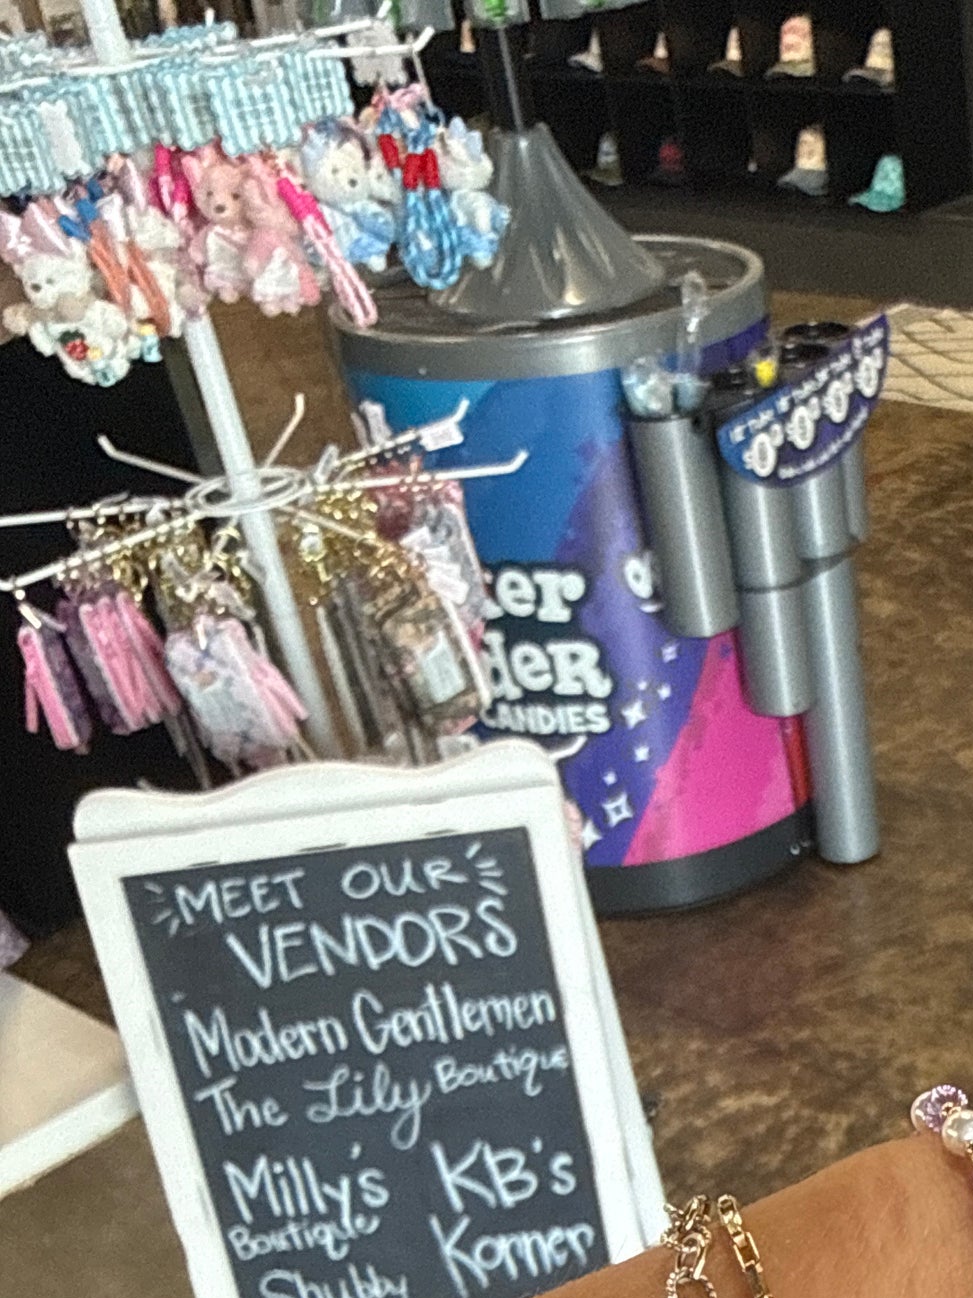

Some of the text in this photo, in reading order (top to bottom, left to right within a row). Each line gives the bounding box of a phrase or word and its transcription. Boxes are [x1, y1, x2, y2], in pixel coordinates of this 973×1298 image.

[480, 564, 586, 623] er
[479, 701, 612, 735] CANDIES
[173, 856, 469, 926] MEET OUR
[224, 898, 519, 990] VENDORS
[182, 980, 559, 1079] Modern Gentlemen
[194, 1043, 572, 1151] The Lily Boutique
[221, 1140, 391, 1240] Milly's
[430, 1135, 578, 1214] KB's
